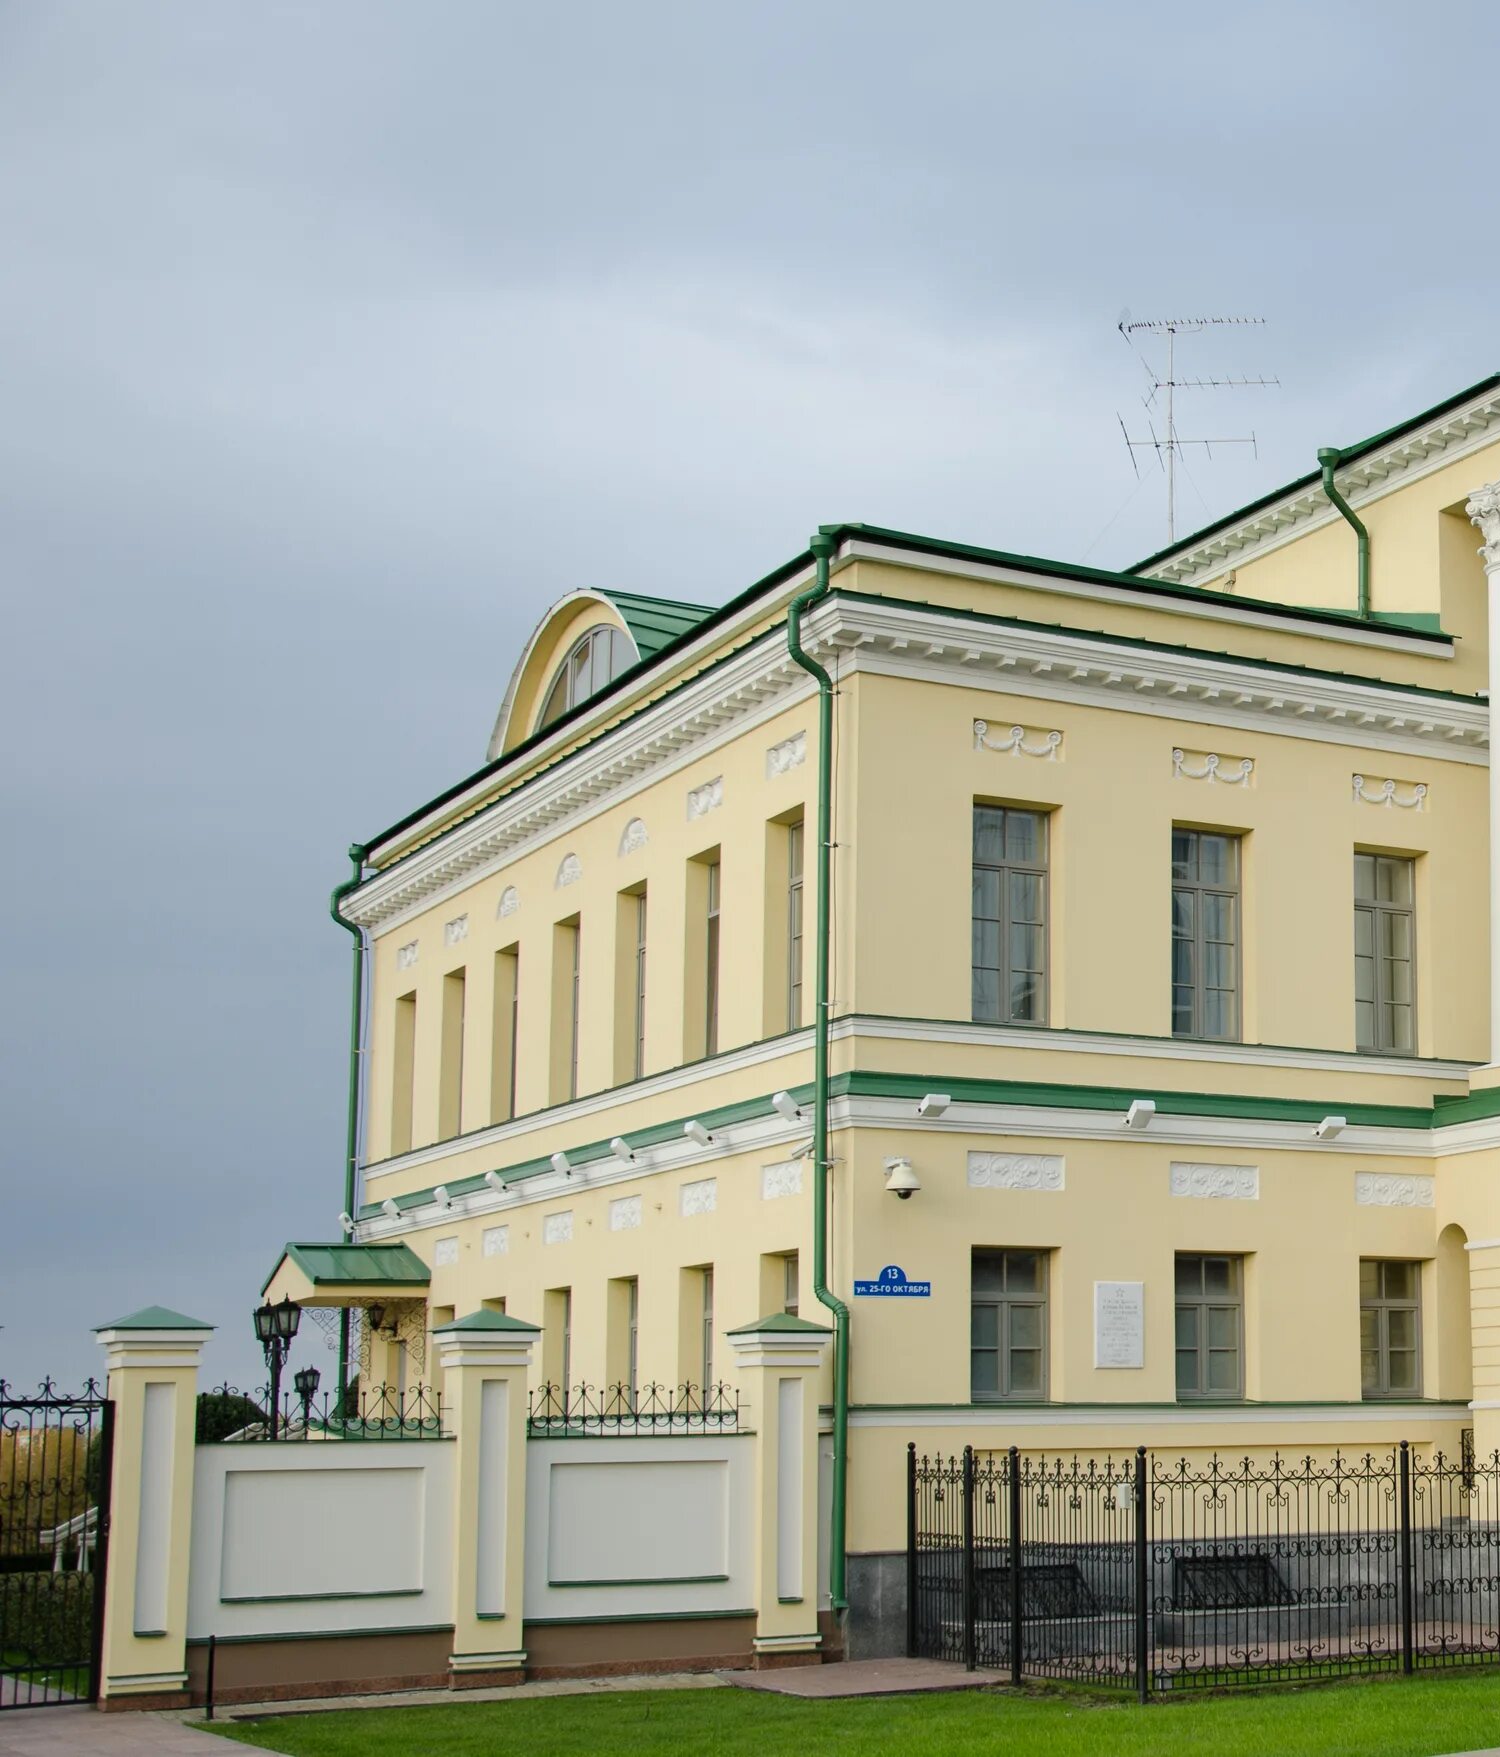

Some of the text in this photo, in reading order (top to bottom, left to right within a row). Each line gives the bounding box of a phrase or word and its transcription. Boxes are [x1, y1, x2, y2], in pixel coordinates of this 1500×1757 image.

[887, 1269, 898, 1279] 13
[869, 1285, 891, 1293] 25-ГО
[892, 1285, 929, 1293] ОКТЯБРЯ
